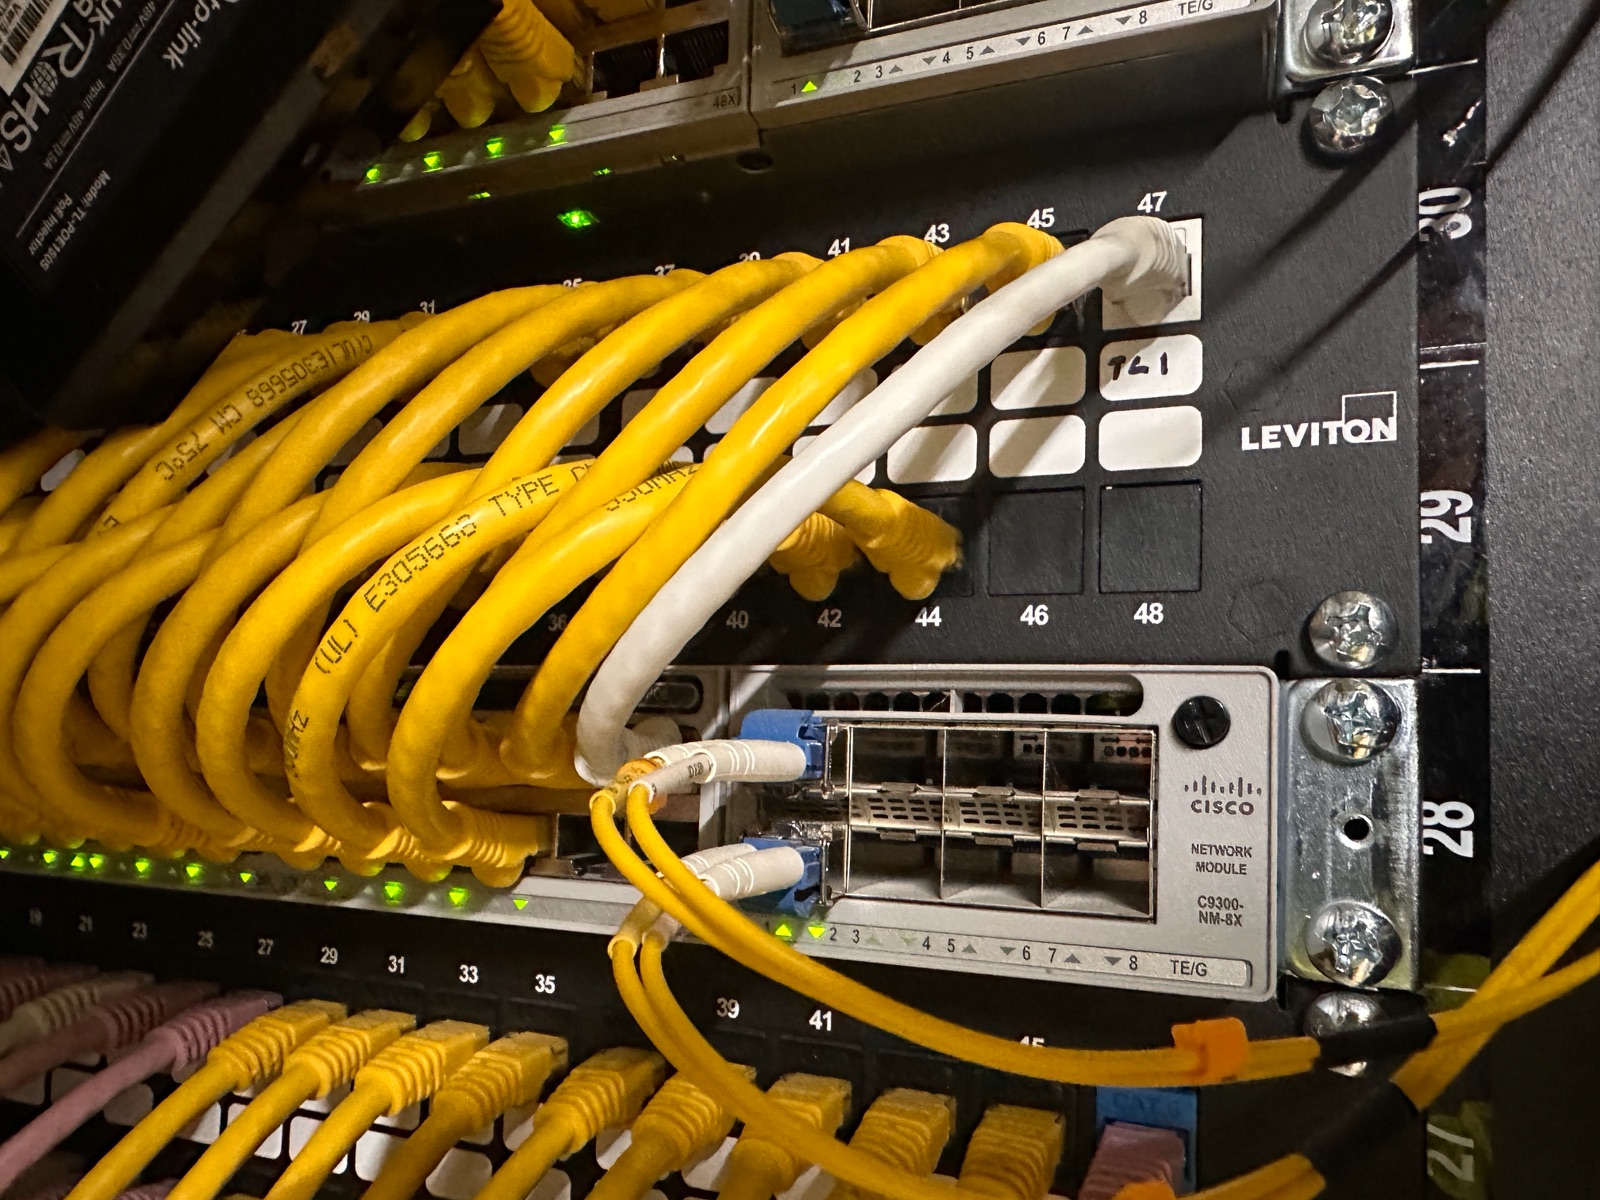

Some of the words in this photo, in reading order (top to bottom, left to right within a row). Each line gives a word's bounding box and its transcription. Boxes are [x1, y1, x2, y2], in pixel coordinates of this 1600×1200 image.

[854, 70, 861, 83] 2
[875, 65, 883, 78] 3
[942, 52, 951, 64] 4
[966, 46, 974, 60] 5
[1037, 31, 1046, 45] 6
[1062, 26, 1071, 41] 7
[1138, 11, 1148, 25] 8
[827, 238, 850, 258] 41
[924, 223, 950, 244] 43
[1027, 207, 1056, 229] 45
[1137, 191, 1167, 213] 47
[1241, 416, 1397, 451] LEVITON
[488, 474, 560, 516] TYPE
[1420, 490, 1473, 543] 29
[726, 610, 749, 630] 40
[817, 608, 842, 628] 42
[915, 606, 942, 627] 44
[1020, 604, 1049, 626] 46
[1133, 602, 1164, 625] 48
[1191, 843, 1253, 858] NETWORK
[1422, 801, 1475, 858] 28
[1195, 861, 1247, 875] MODULE
[1198, 910, 1243, 927] NM-8X
[829, 926, 837, 942] 2
[852, 929, 860, 944] 3
[921, 936, 931, 951] 4
[947, 938, 955, 953] 5
[1022, 945, 1031, 961] 6
[1048, 947, 1057, 963] 7
[1128, 954, 1138, 971] 8
[1170, 959, 1208, 977] TE/G
[320, 946, 338, 965] 29
[388, 955, 405, 974] 31
[459, 964, 479, 984] 33
[534, 974, 556, 994] 35
[716, 997, 740, 1019] 39
[808, 1010, 832, 1031] 41
